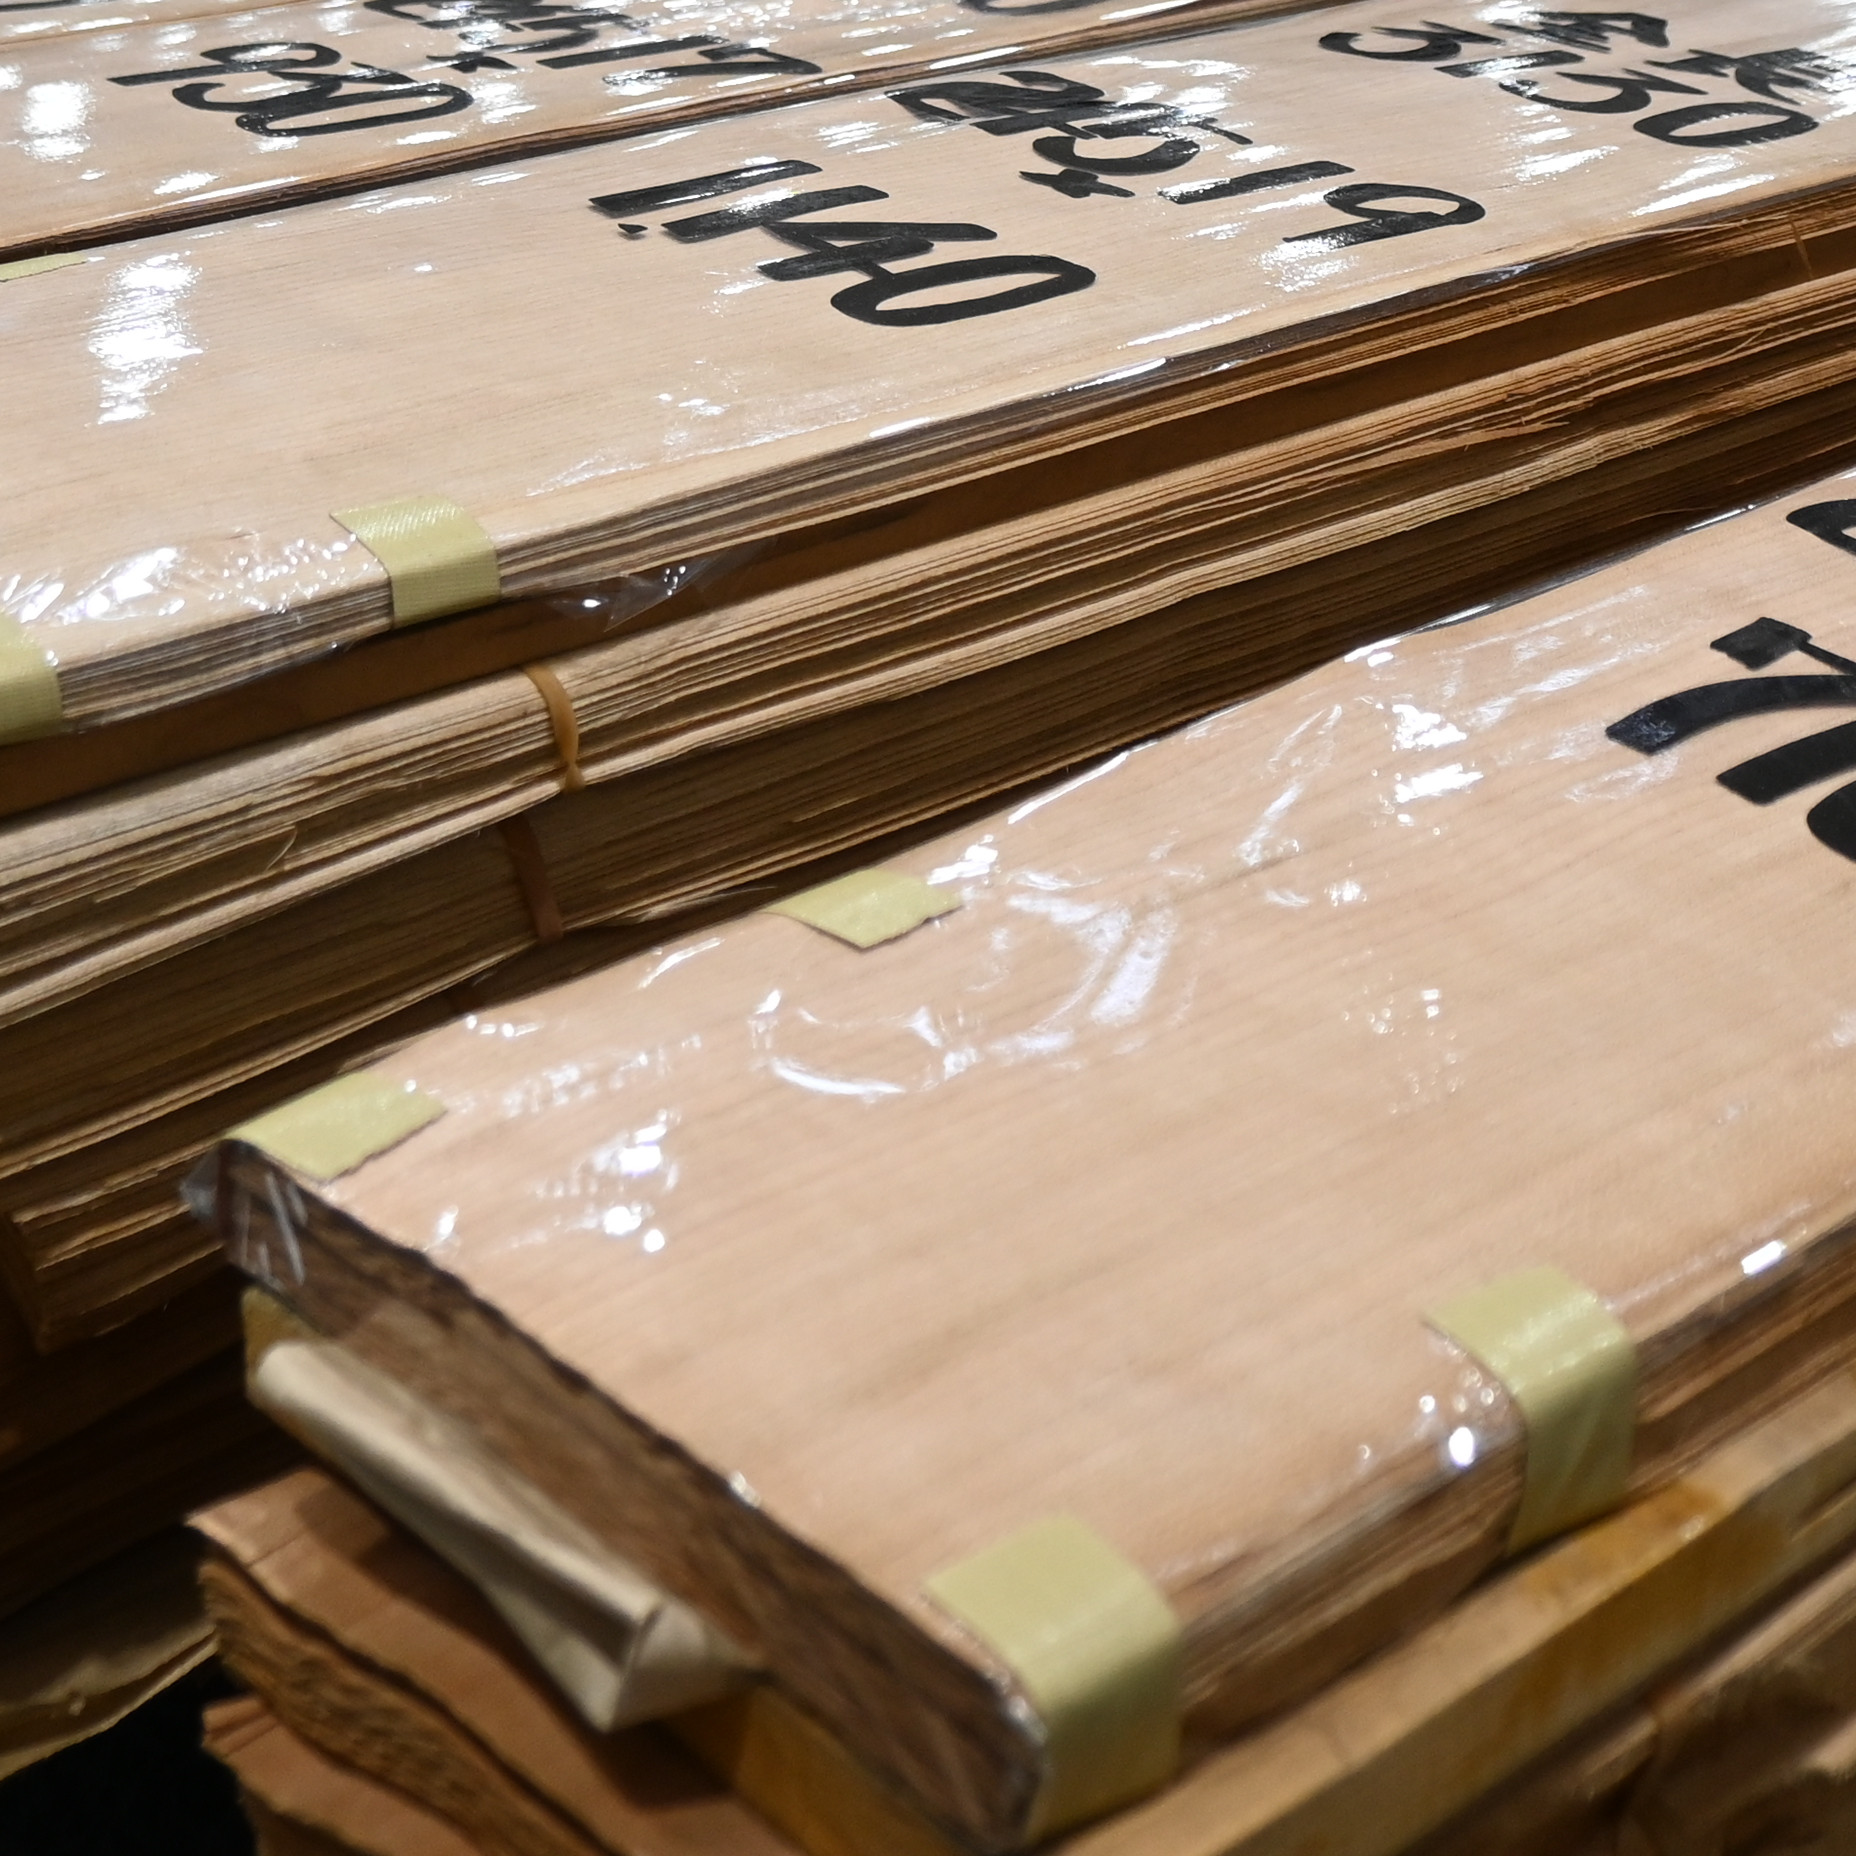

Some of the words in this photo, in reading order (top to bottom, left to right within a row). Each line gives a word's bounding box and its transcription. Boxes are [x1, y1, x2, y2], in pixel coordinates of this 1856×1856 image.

[106, 41, 474, 137] 930
[1319, 20, 1820, 148] 3130
[885, 69, 1253, 175] 245
[1157, 158, 1486, 250] 19
